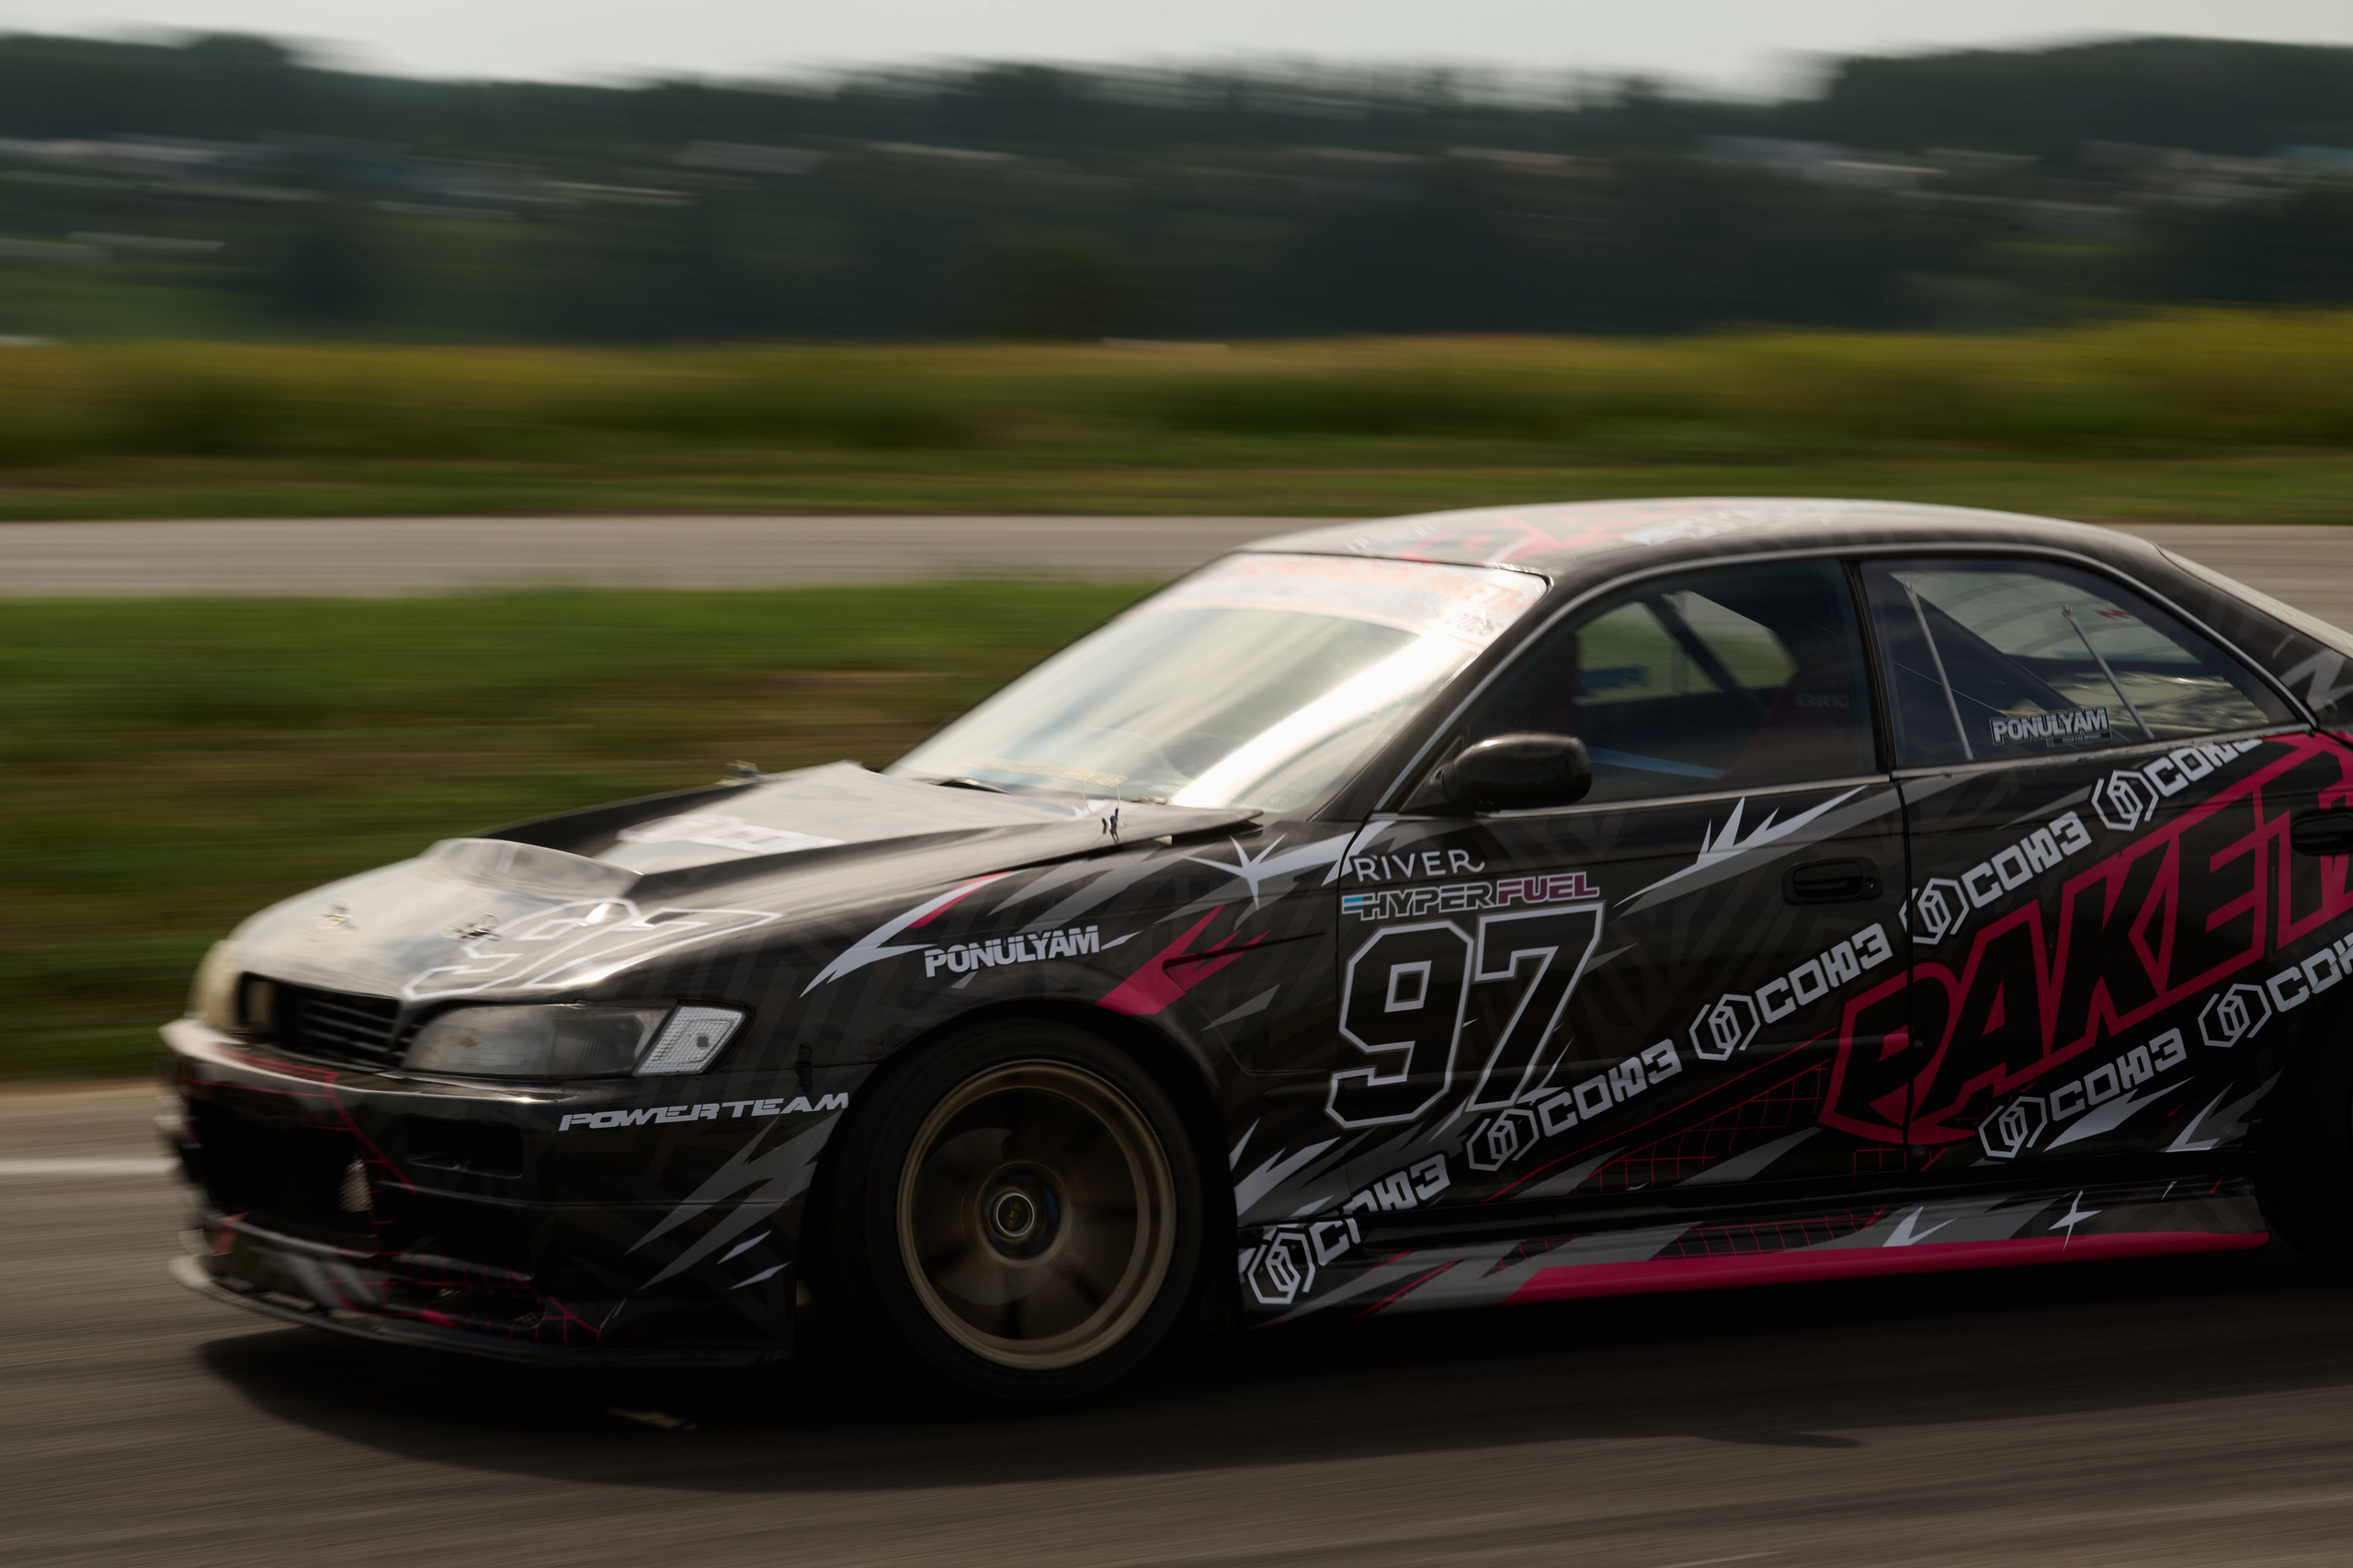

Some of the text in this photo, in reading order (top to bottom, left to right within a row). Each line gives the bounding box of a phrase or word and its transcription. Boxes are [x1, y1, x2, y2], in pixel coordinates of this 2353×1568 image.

[1992, 707, 2109, 744] PONULYAM
[1354, 849, 1484, 882] RIVER
[925, 925, 1100, 977] PONULYAM
[1817, 731, 2353, 1146] РАКЕТ
[1324, 900, 1604, 1130] 97
